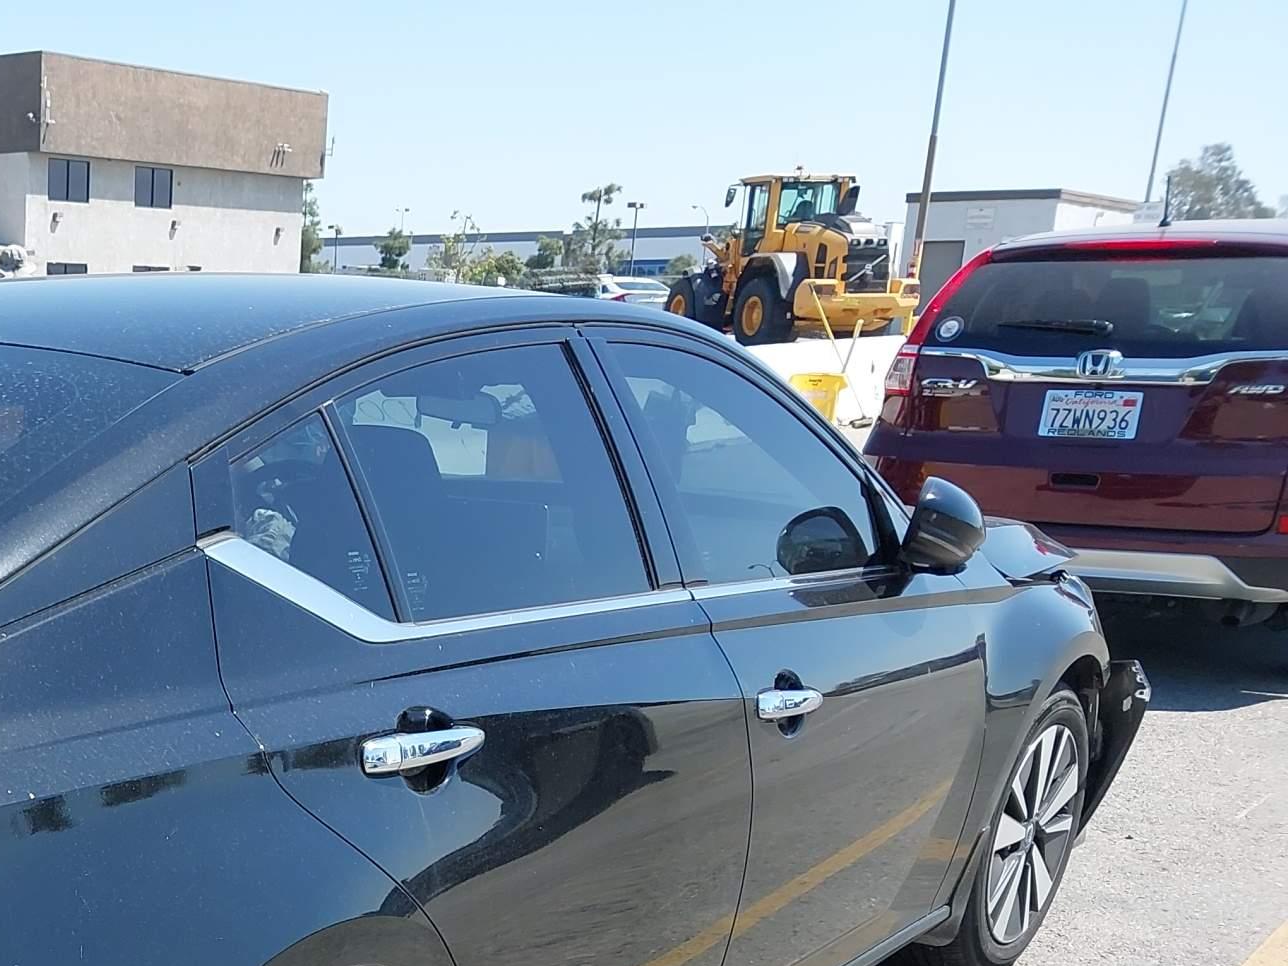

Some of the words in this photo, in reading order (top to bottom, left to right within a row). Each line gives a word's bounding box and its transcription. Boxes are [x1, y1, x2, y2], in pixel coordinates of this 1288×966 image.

[1228, 384, 1285, 395] AWD
[1073, 391, 1114, 399] FORD
[1049, 408, 1132, 430] 7ZWN936
[1047, 428, 1127, 438] REDLANDS
